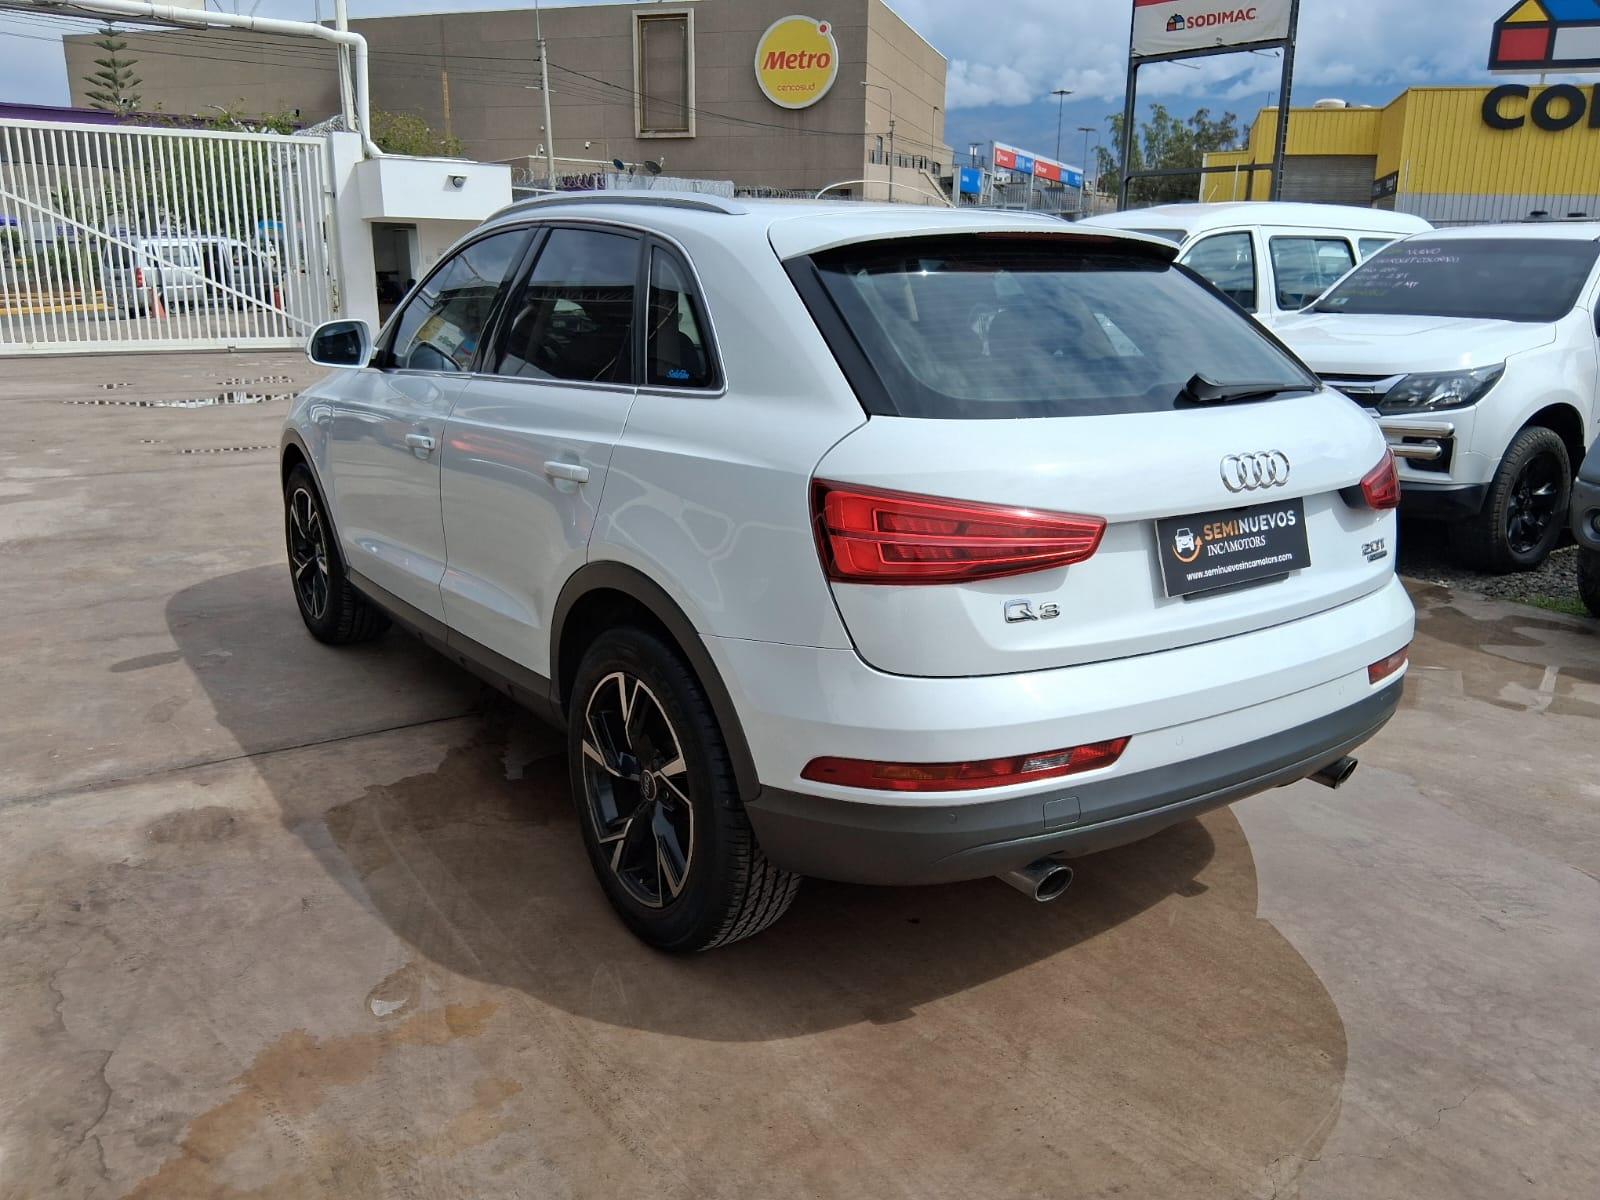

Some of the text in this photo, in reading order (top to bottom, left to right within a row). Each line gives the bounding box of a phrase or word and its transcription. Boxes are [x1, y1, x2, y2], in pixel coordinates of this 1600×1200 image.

[1186, 8, 1257, 29] SODIMAC
[763, 50, 831, 70] Metro
[777, 82, 815, 92] cencosud
[1482, 83, 1600, 132] CO
[1202, 510, 1297, 541] SEMINUEVOS
[1207, 535, 1266, 557] INCAMOTORS
[1186, 552, 1293, 582] www.seminuevosincamotors.com
[1003, 599, 1061, 624] Q3
